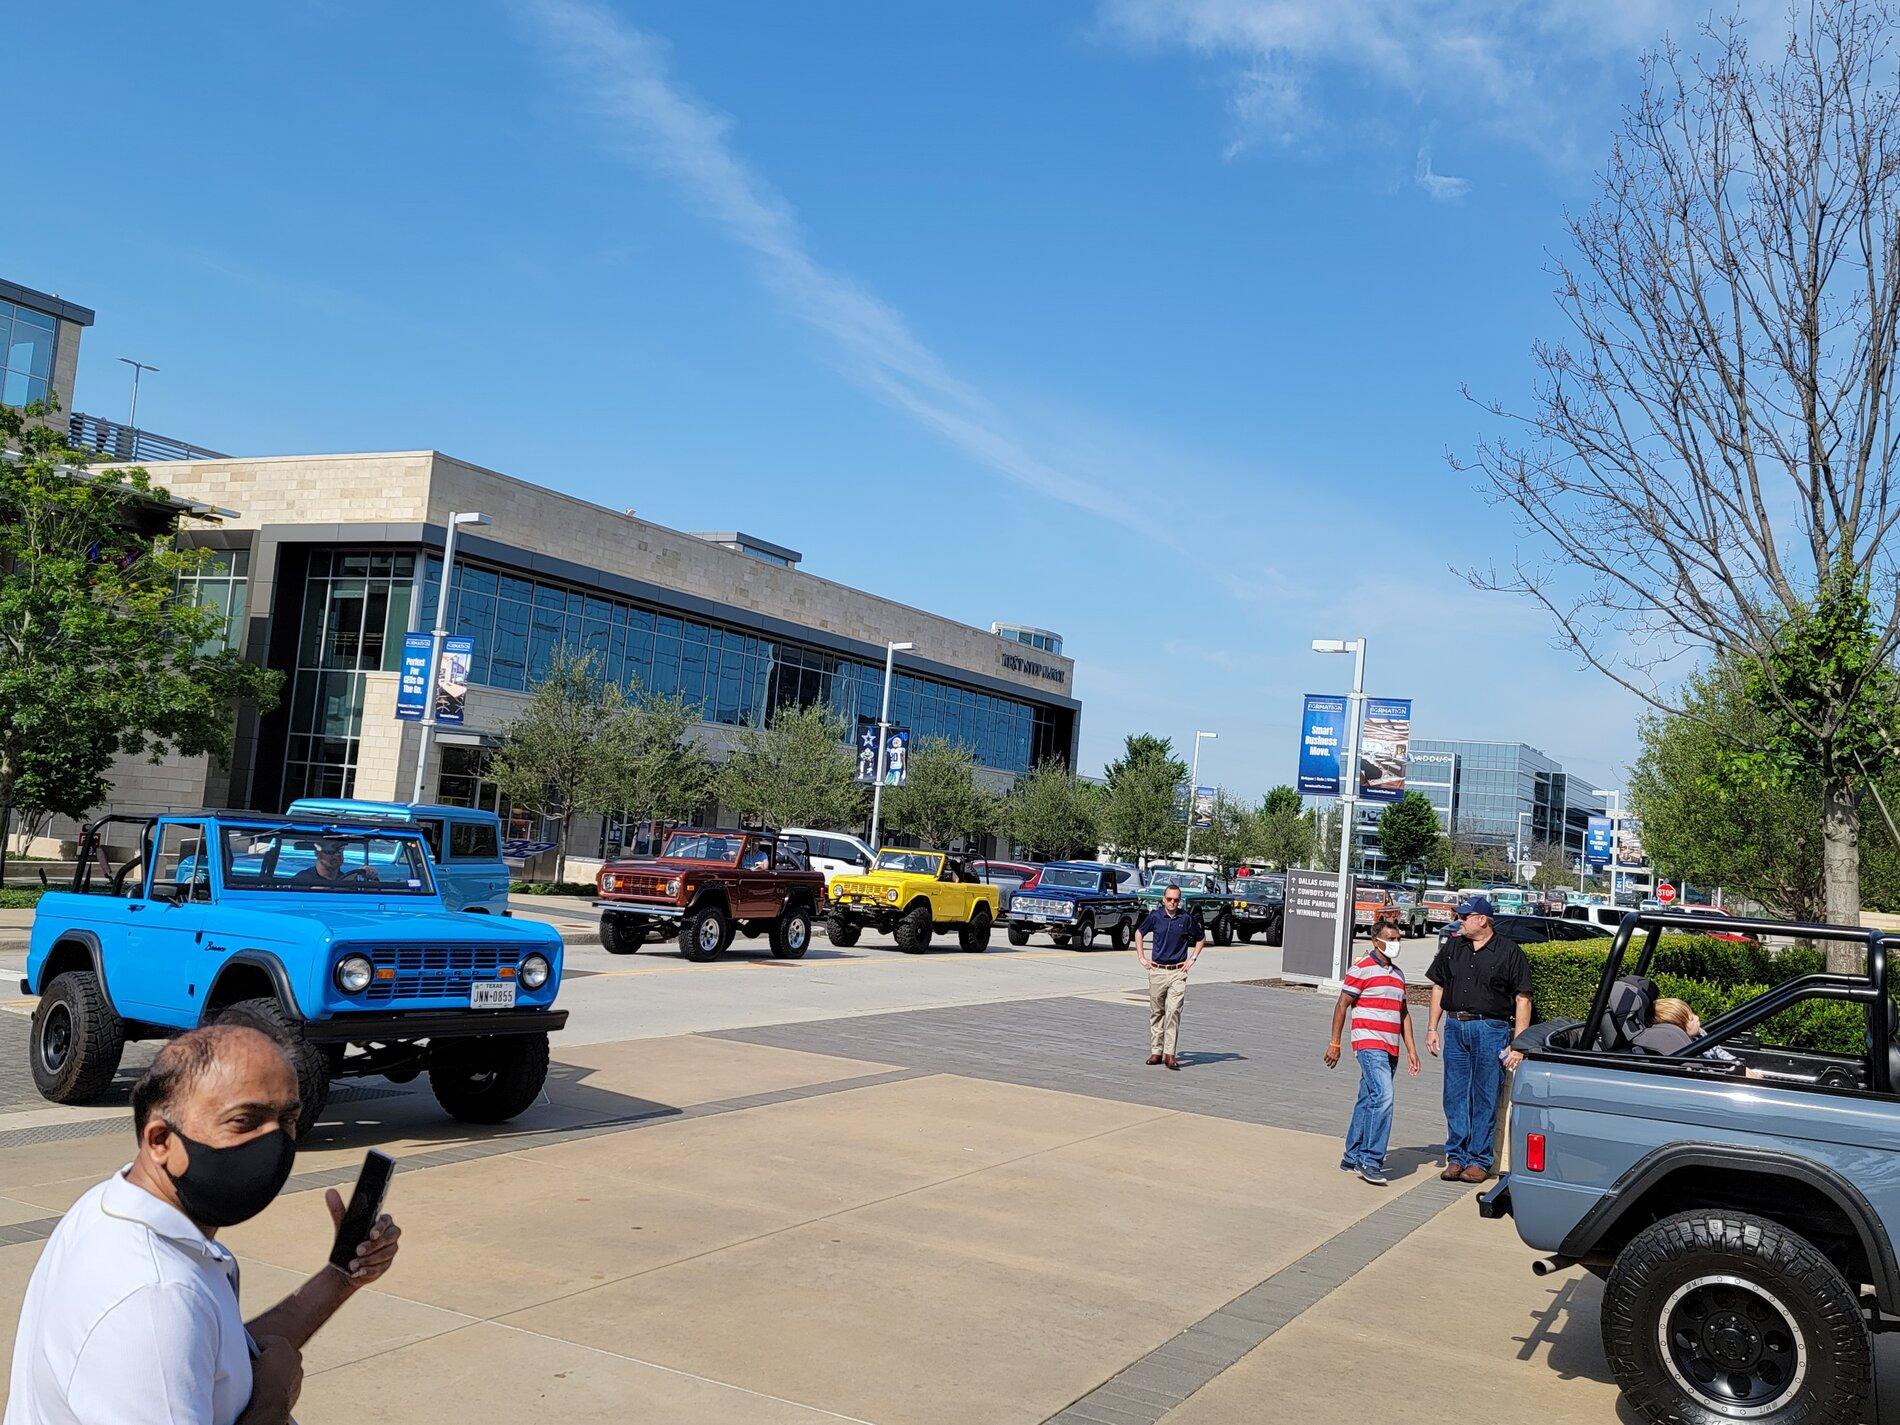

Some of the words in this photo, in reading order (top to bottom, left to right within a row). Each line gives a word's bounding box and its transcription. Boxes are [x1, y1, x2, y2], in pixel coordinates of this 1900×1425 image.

[406, 657, 425, 666] Perfect
[410, 667, 419, 675] For
[403, 685, 413, 693] The
[1311, 726, 1334, 735] Smart
[1305, 736, 1338, 746] Business
[1309, 746, 1331, 757] Move.
[1298, 878, 1318, 886] DALLAS
[1318, 880, 1339, 888] COWBO
[1297, 888, 1324, 897] COWBOYS
[1658, 889, 1675, 897] STOP
[1296, 898, 1311, 907] BLUE
[1311, 900, 1336, 909] PARKING
[1296, 909, 1320, 917] WINNING
